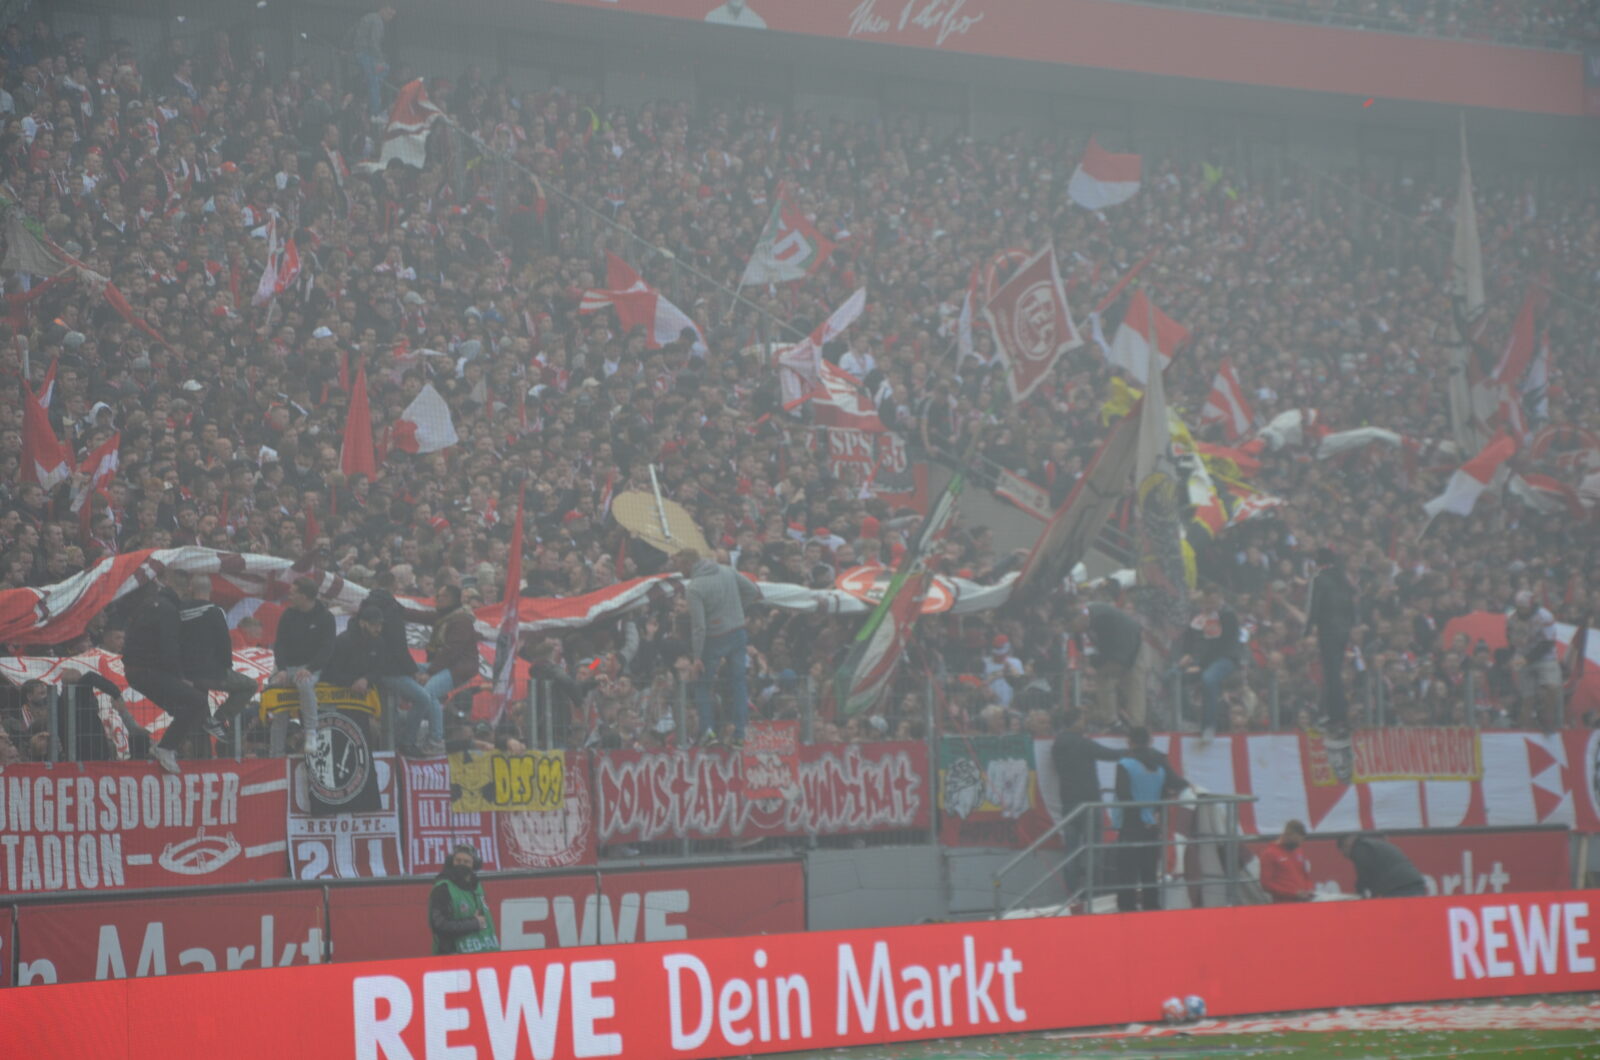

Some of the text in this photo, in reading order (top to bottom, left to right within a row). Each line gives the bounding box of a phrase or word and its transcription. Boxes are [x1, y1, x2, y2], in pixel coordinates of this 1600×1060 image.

[307, 819, 382, 833] REVOLTE
[0, 833, 125, 891] TADION
[501, 891, 690, 951] EWE
[1448, 901, 1597, 980] REWE
[353, 934, 1028, 1060] REWE Dein Markt
